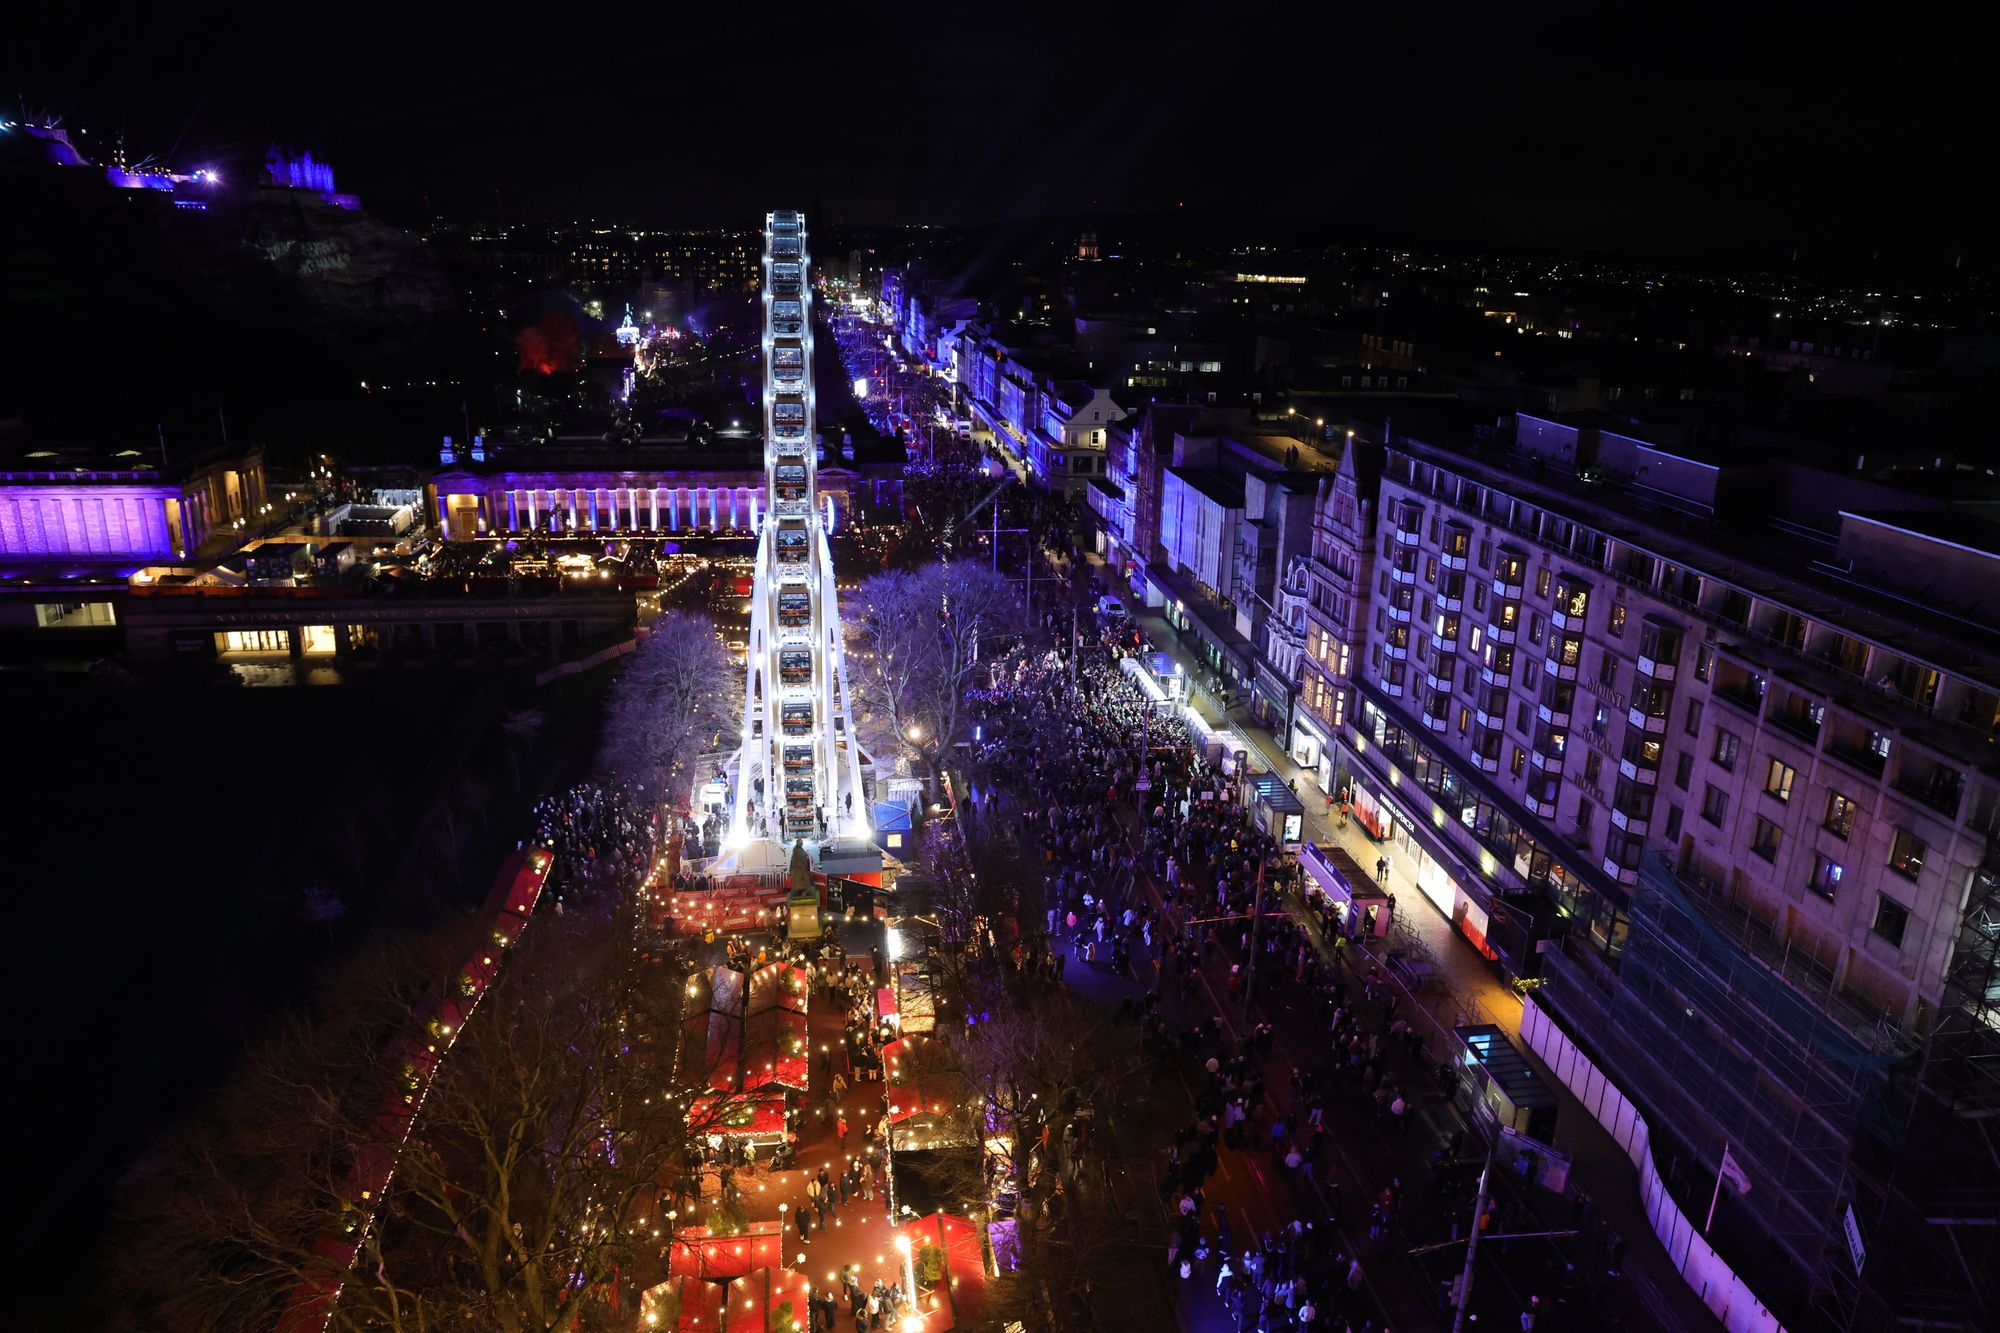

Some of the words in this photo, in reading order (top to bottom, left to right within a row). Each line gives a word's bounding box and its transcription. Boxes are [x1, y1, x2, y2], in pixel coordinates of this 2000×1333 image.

[1586, 675, 1625, 707] MOUNT
[1582, 724, 1614, 757] ROYAL
[1575, 771, 1606, 803] HOTEL
